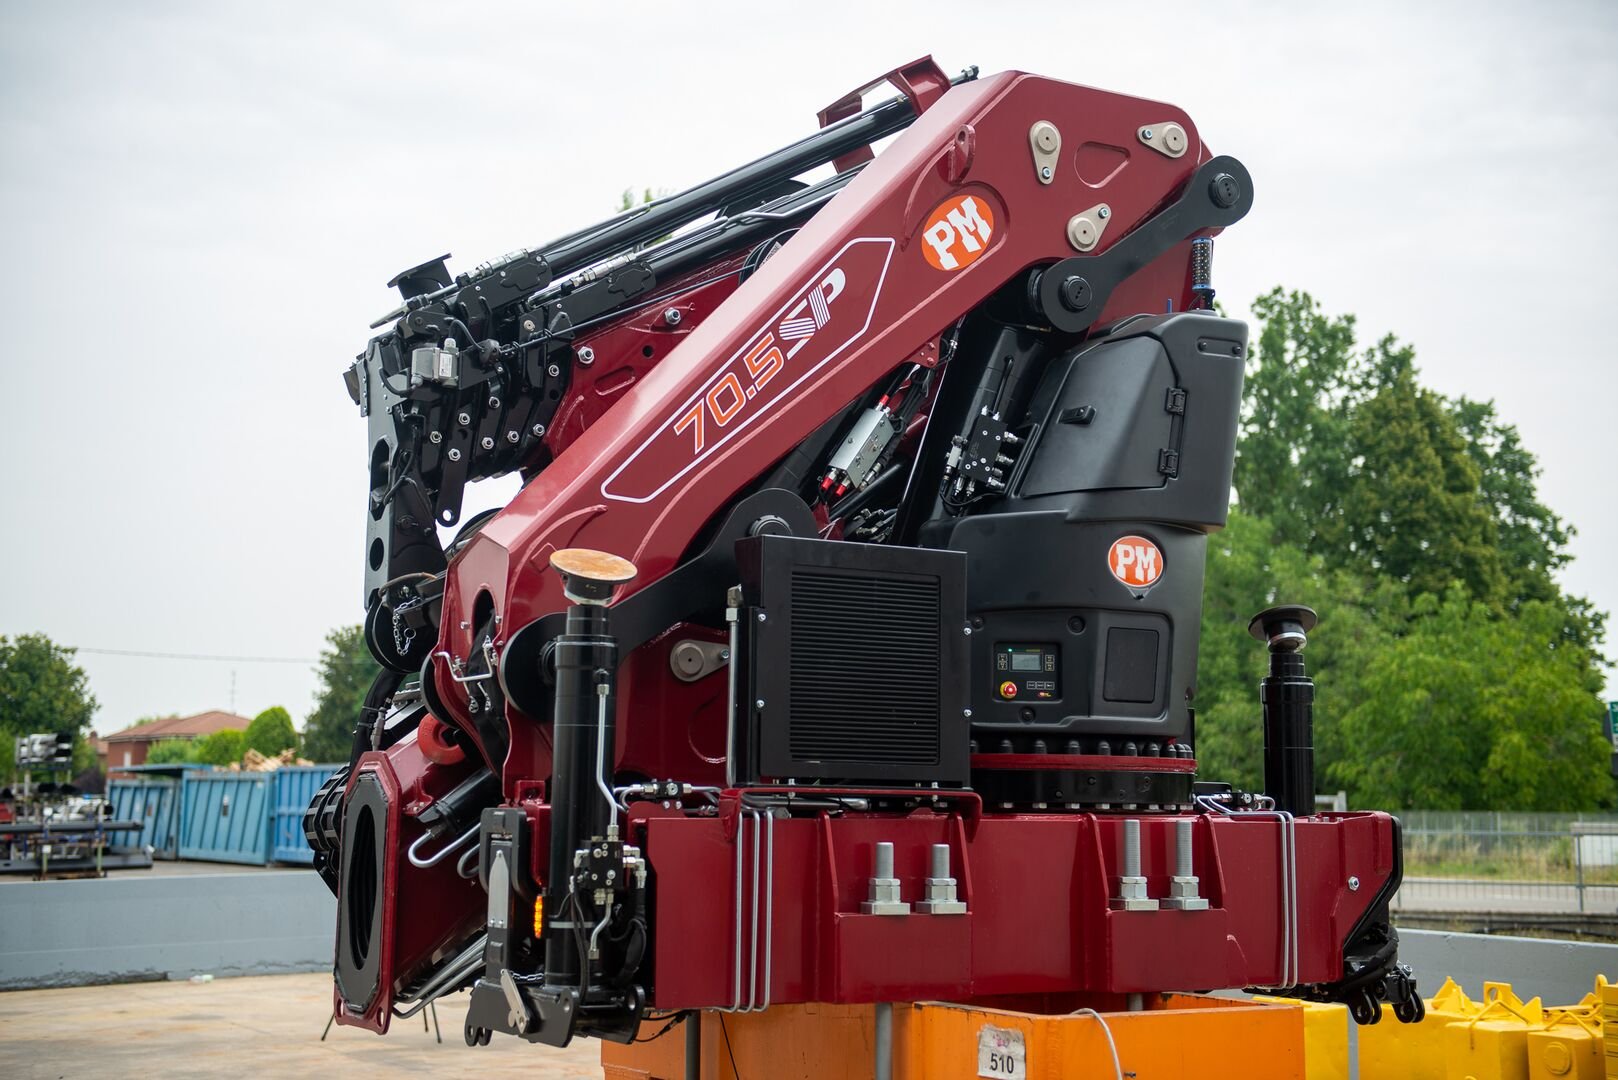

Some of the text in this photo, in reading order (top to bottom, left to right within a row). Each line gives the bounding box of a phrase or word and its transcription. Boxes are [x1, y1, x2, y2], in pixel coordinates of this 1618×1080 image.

[923, 196, 992, 271] PM
[673, 331, 785, 455] 70.5
[1115, 543, 1156, 582] PM
[990, 1052, 1014, 1074] 510
